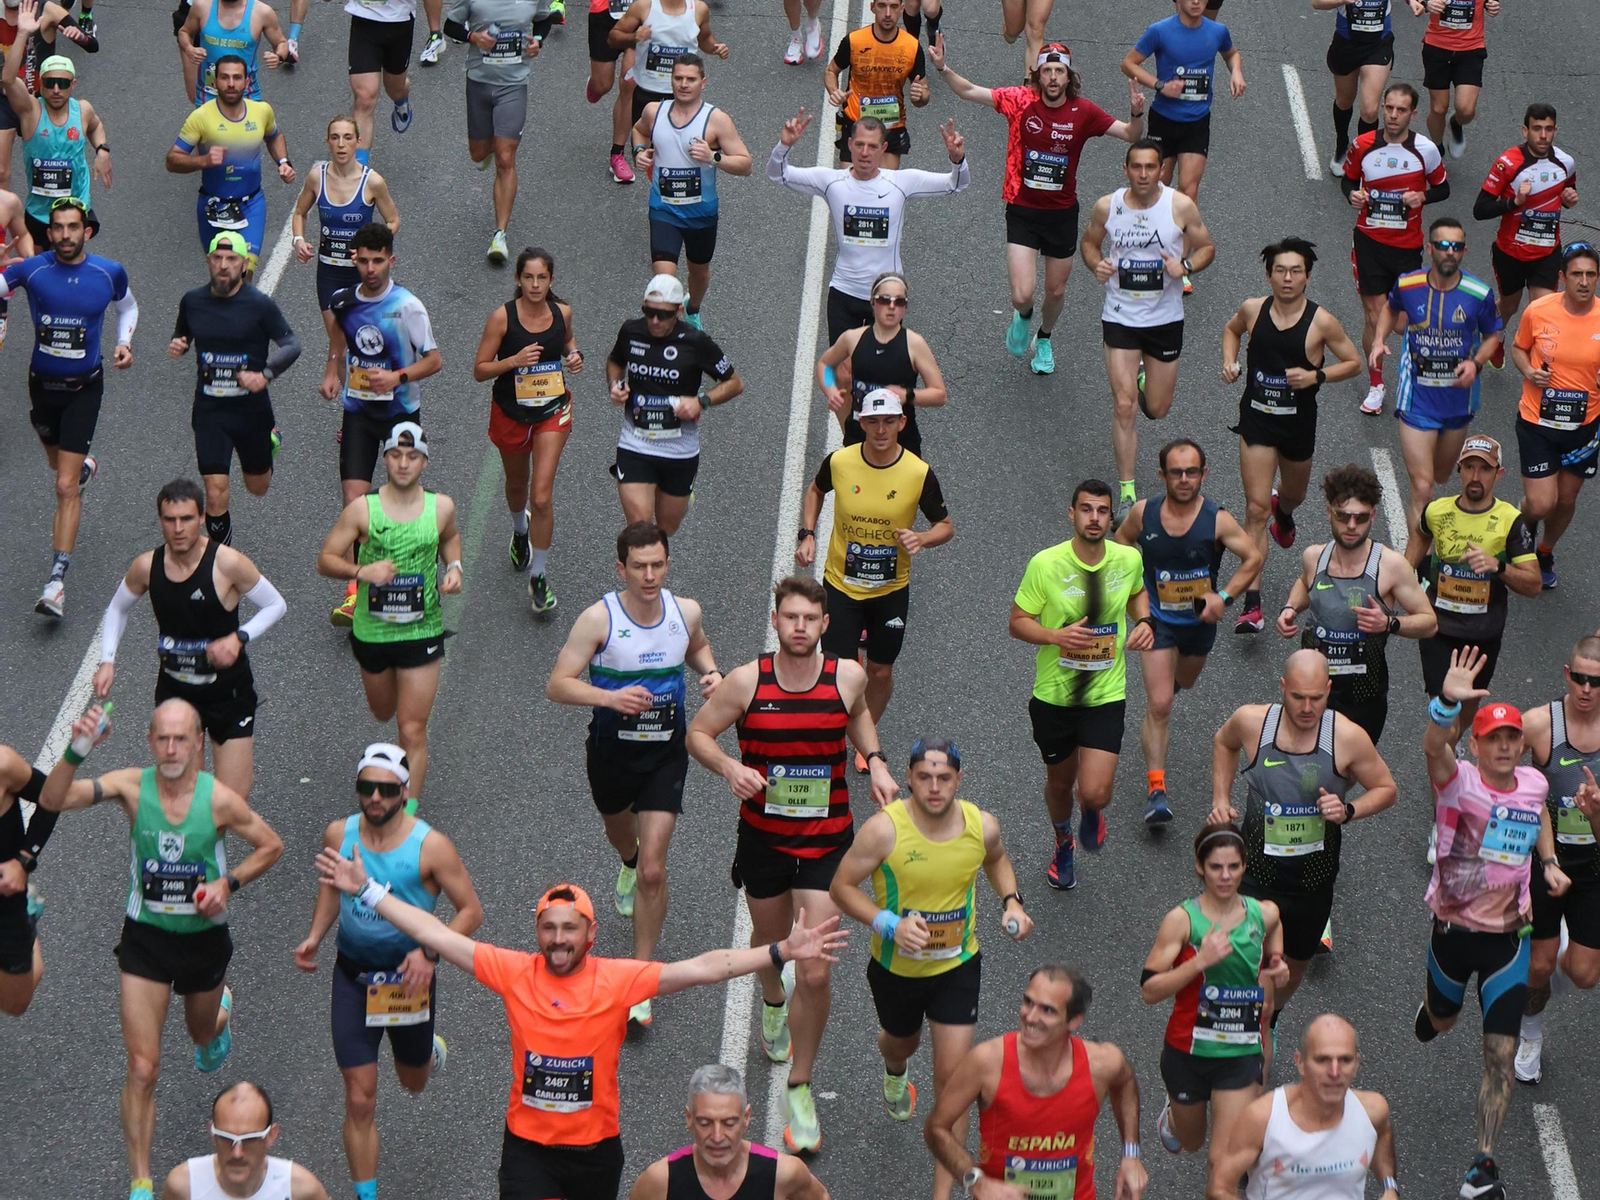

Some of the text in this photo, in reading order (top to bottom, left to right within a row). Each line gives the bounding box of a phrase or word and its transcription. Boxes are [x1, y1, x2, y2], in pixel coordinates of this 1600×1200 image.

[1040, 153, 1066, 163] ZURICH
[332, 229, 356, 237] ZURICH
[1132, 261, 1158, 269] ZURICH
[1432, 349, 1459, 357] ZURICH
[216, 355, 243, 363] ZURICH
[360, 360, 386, 368] ZURICH
[531, 364, 557, 372] ZURICH
[1555, 404, 1572, 412] 3433
[851, 515, 891, 526] WIKABOO
[863, 547, 892, 555] ZURICH
[857, 572, 884, 580] PACHECO
[1174, 571, 1203, 580] ZURICH
[1454, 568, 1485, 579] ZURICH
[1329, 631, 1360, 640] ZURICH
[1327, 645, 1347, 655] 2117
[637, 723, 662, 731] STUART
[788, 767, 825, 777] ZURICH
[788, 784, 809, 794] 1378
[788, 797, 807, 805] OLLIE
[1285, 805, 1320, 815] ZURICH
[1511, 812, 1538, 824] ZURICH
[1285, 823, 1305, 832] 1871
[1288, 836, 1302, 844] JOS
[162, 863, 199, 874] ZURICH
[926, 910, 960, 921] ZURICH
[1223, 990, 1258, 999] ZURICH
[545, 1057, 586, 1069] ZURICH
[544, 1076, 569, 1087] 2487
[535, 1089, 578, 1101] CARLOS FC
[1008, 1132, 1075, 1152] ESPAÑA
[1030, 1159, 1070, 1170] ZURICH
